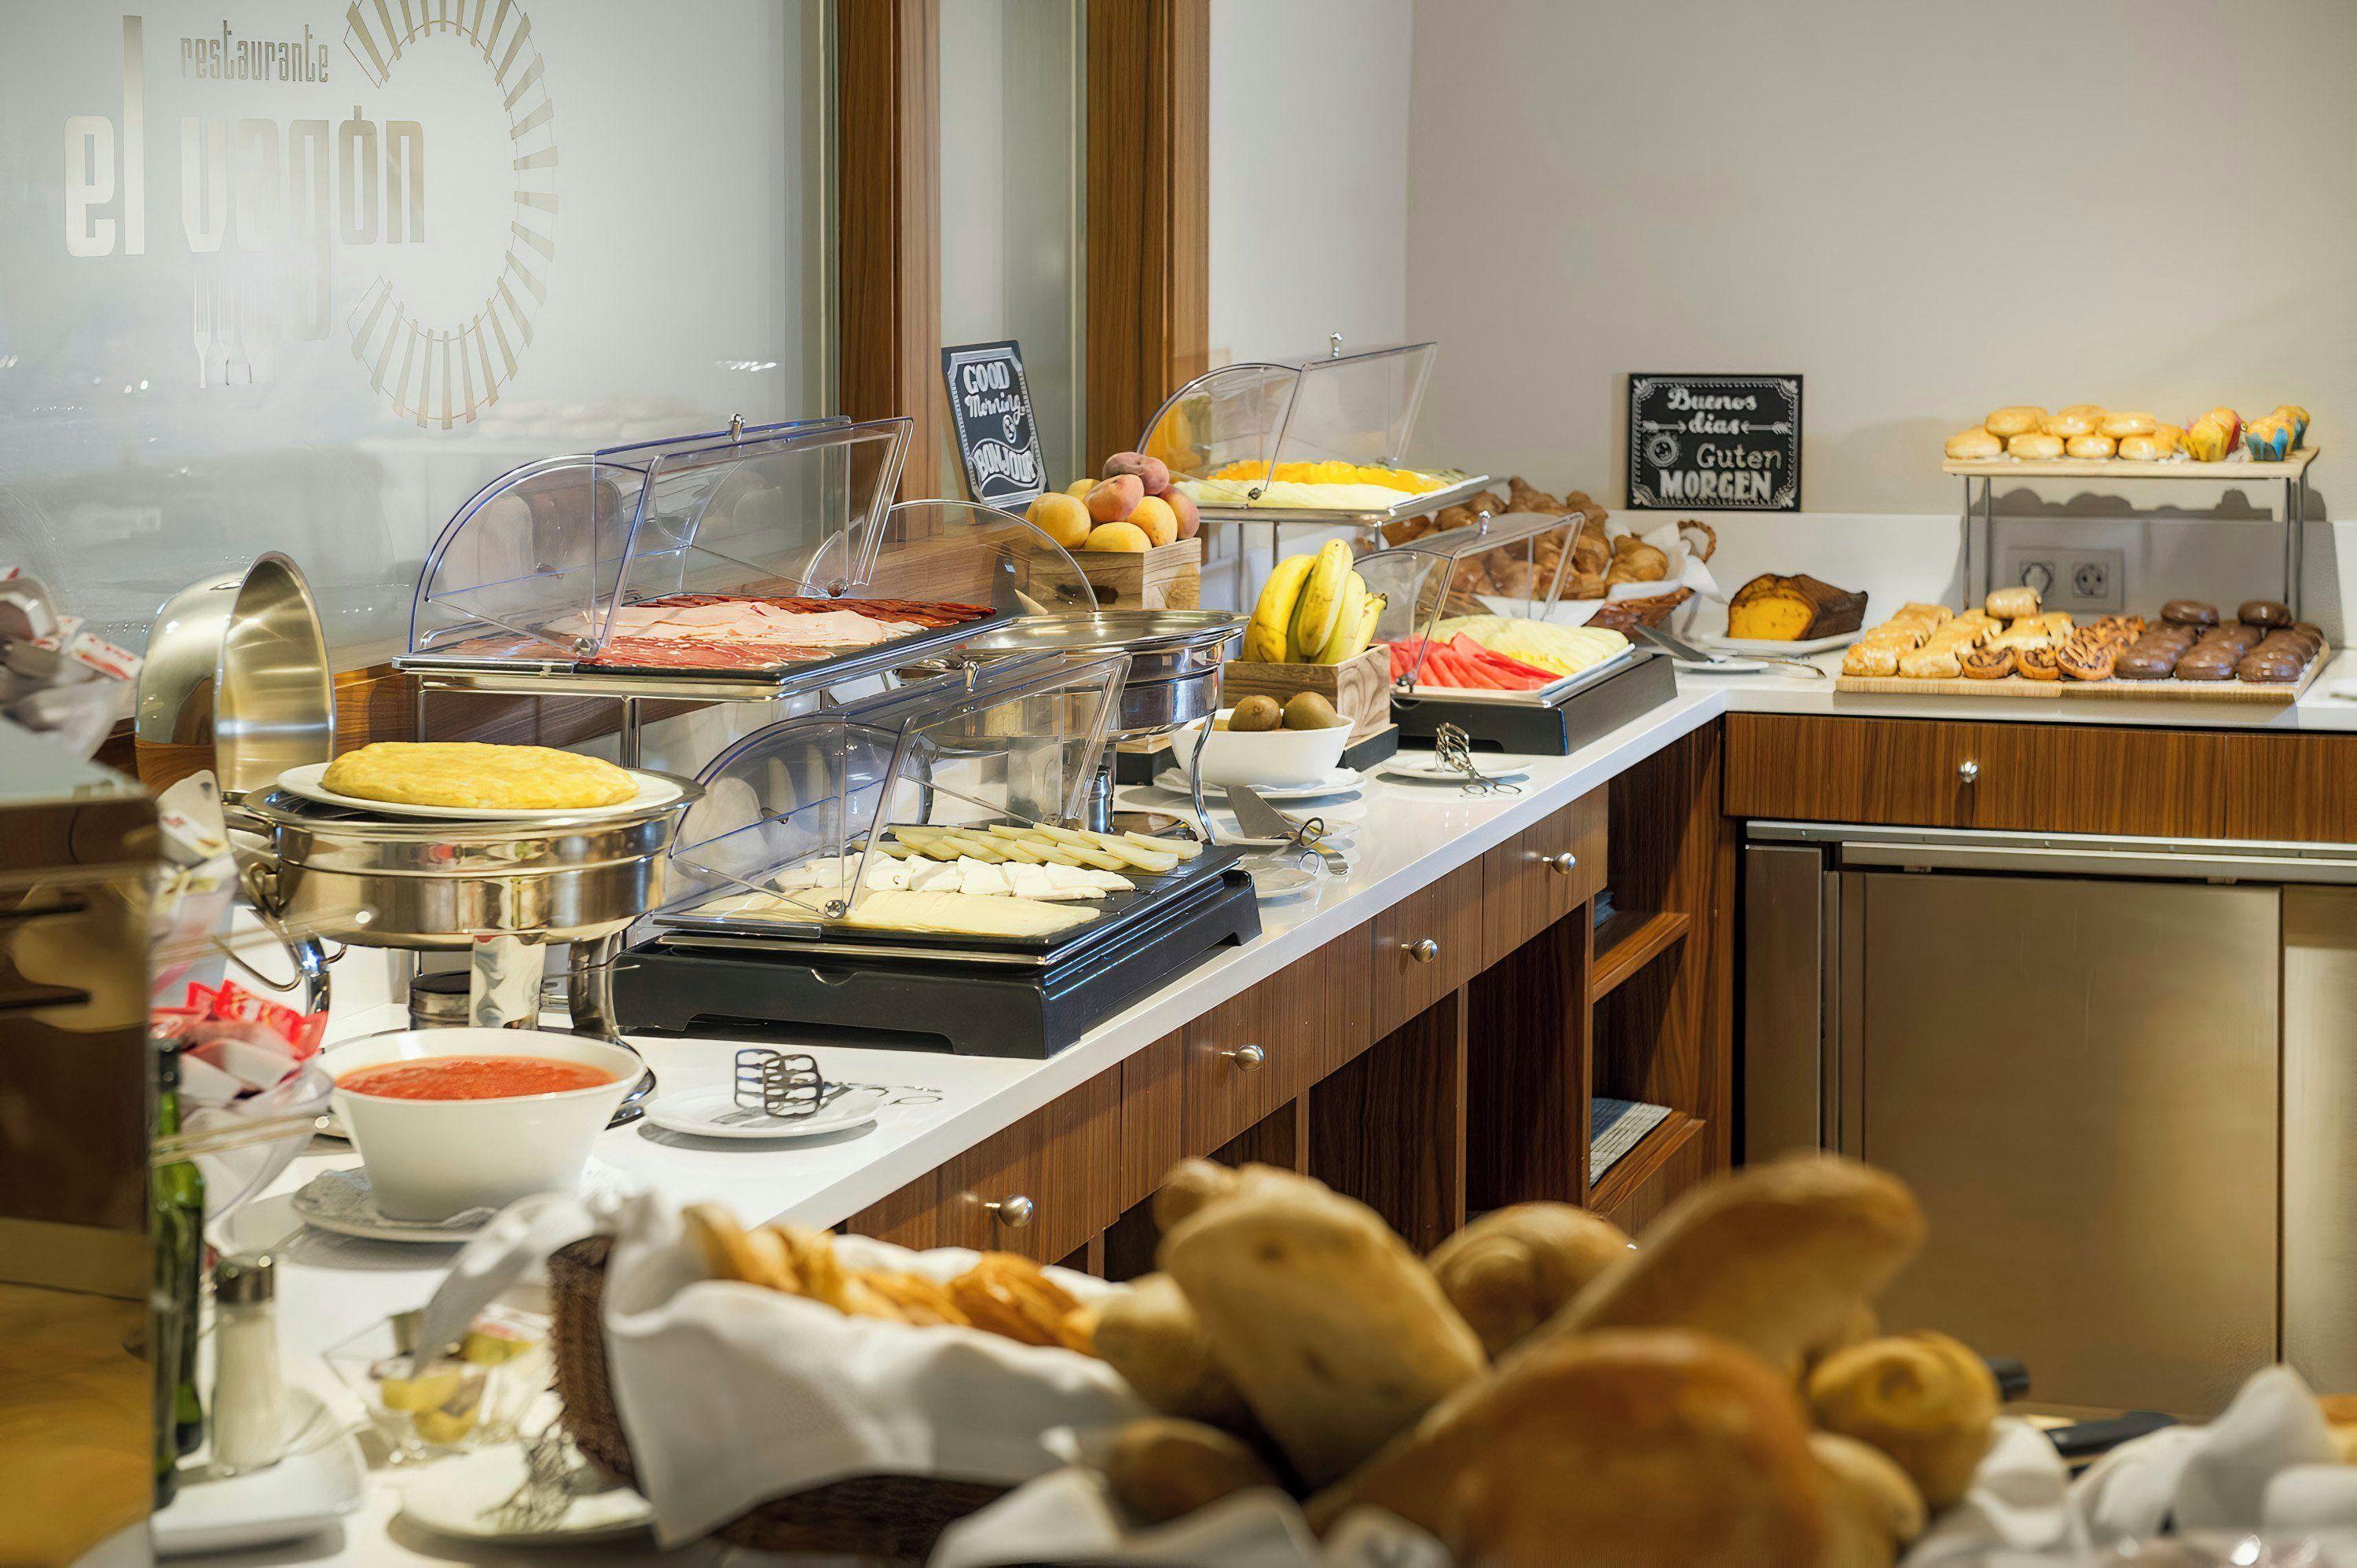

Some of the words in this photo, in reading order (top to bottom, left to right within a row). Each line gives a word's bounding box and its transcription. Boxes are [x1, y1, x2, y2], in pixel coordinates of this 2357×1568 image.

[181, 20, 328, 82] restaurante
[64, 15, 145, 257] el
[963, 361, 1010, 394] GOOD
[965, 392, 1026, 425] Morning
[1667, 387, 1758, 411] Buenos
[973, 443, 1037, 482] BONJOUR
[1696, 442, 1782, 469] Guten
[1659, 471, 1772, 500] MORGEN
